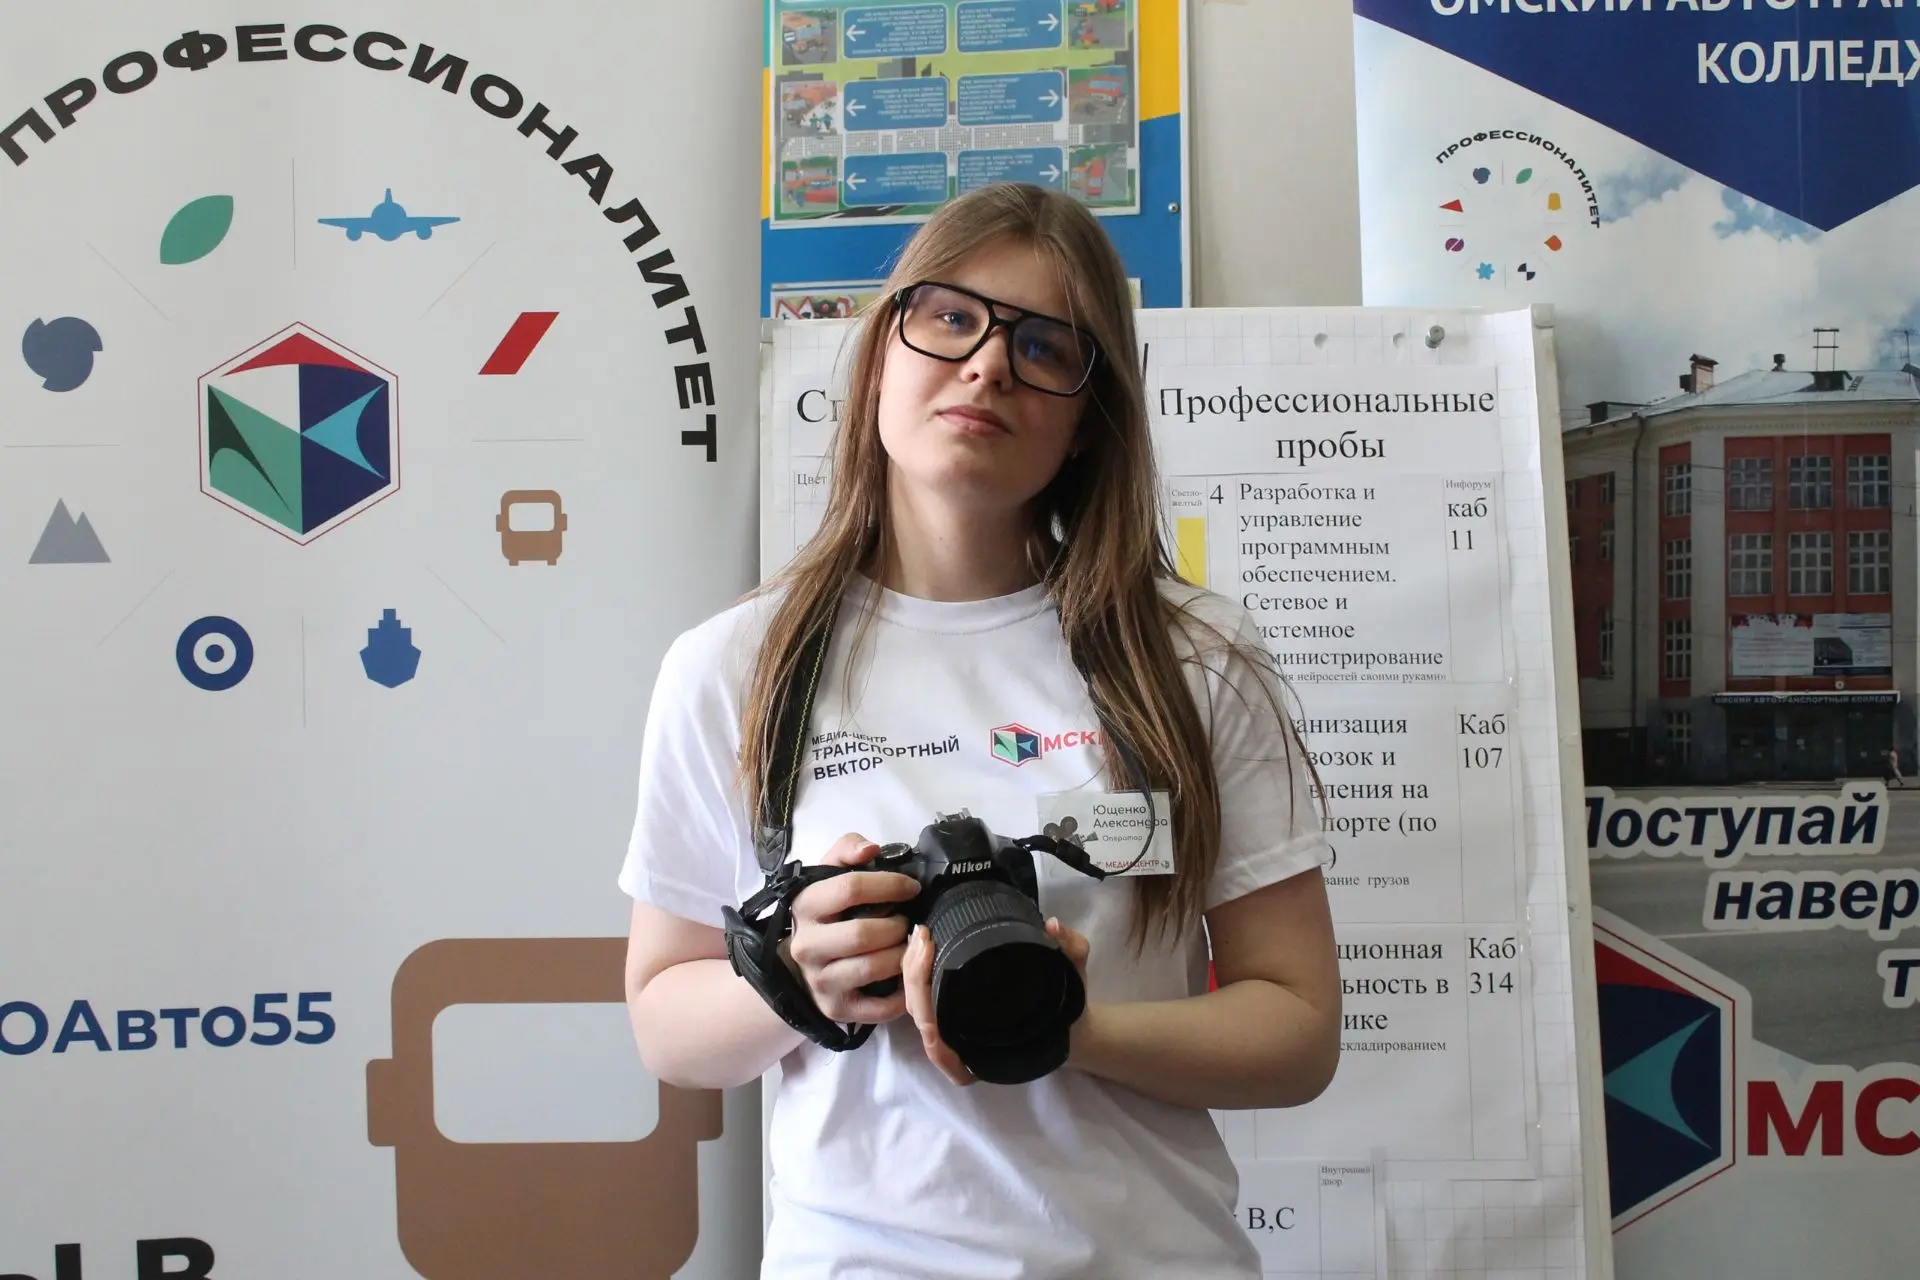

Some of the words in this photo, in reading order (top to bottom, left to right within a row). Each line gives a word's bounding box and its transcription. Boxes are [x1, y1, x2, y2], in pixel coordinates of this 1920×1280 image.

[1436, 130, 1600, 229] ПРОФЕССИОНАЛИТЕТ
[0, 24, 717, 462] ПРОФЕССИОНАЛИТЕТ
[1160, 386, 1495, 423] Профессиональные
[1276, 431, 1386, 466] пробы
[1209, 484, 1224, 505] 4
[1240, 482, 1356, 505] Разработка
[1363, 487, 1376, 500] и
[1445, 479, 1492, 491] Инфорум
[1447, 497, 1488, 518] каб
[1240, 513, 1363, 532] управление
[1451, 529, 1474, 550] 11
[1241, 541, 1390, 560] программным
[1242, 564, 1397, 583] обеспечением.
[1243, 592, 1329, 611] Сетевое
[1335, 597, 1348, 610] и
[1297, 671, 1357, 684] нейросетей
[1360, 672, 1400, 682] своими
[1293, 718, 1408, 737] анизация
[1459, 713, 1506, 736] Каб
[812, 731, 887, 746] МЕДИА-ЦЕНТР
[812, 735, 960, 761] ТРАНСПОРТНЫЙ
[1382, 751, 1396, 766] и
[1462, 746, 1503, 769] 107
[814, 756, 884, 780] ВЕКТОР
[1402, 784, 1429, 799] на
[1093, 804, 1147, 818] Ющенко
[1398, 808, 1437, 837] (по
[951, 859, 992, 875] Nikon
[1367, 876, 1410, 888] грузов
[1337, 943, 1443, 962] ционная
[1468, 937, 1517, 960] Каб
[1342, 978, 1428, 995] ьность
[1436, 978, 1449, 994] в
[1469, 971, 1514, 994] 314
[1343, 1014, 1389, 1031] ике
